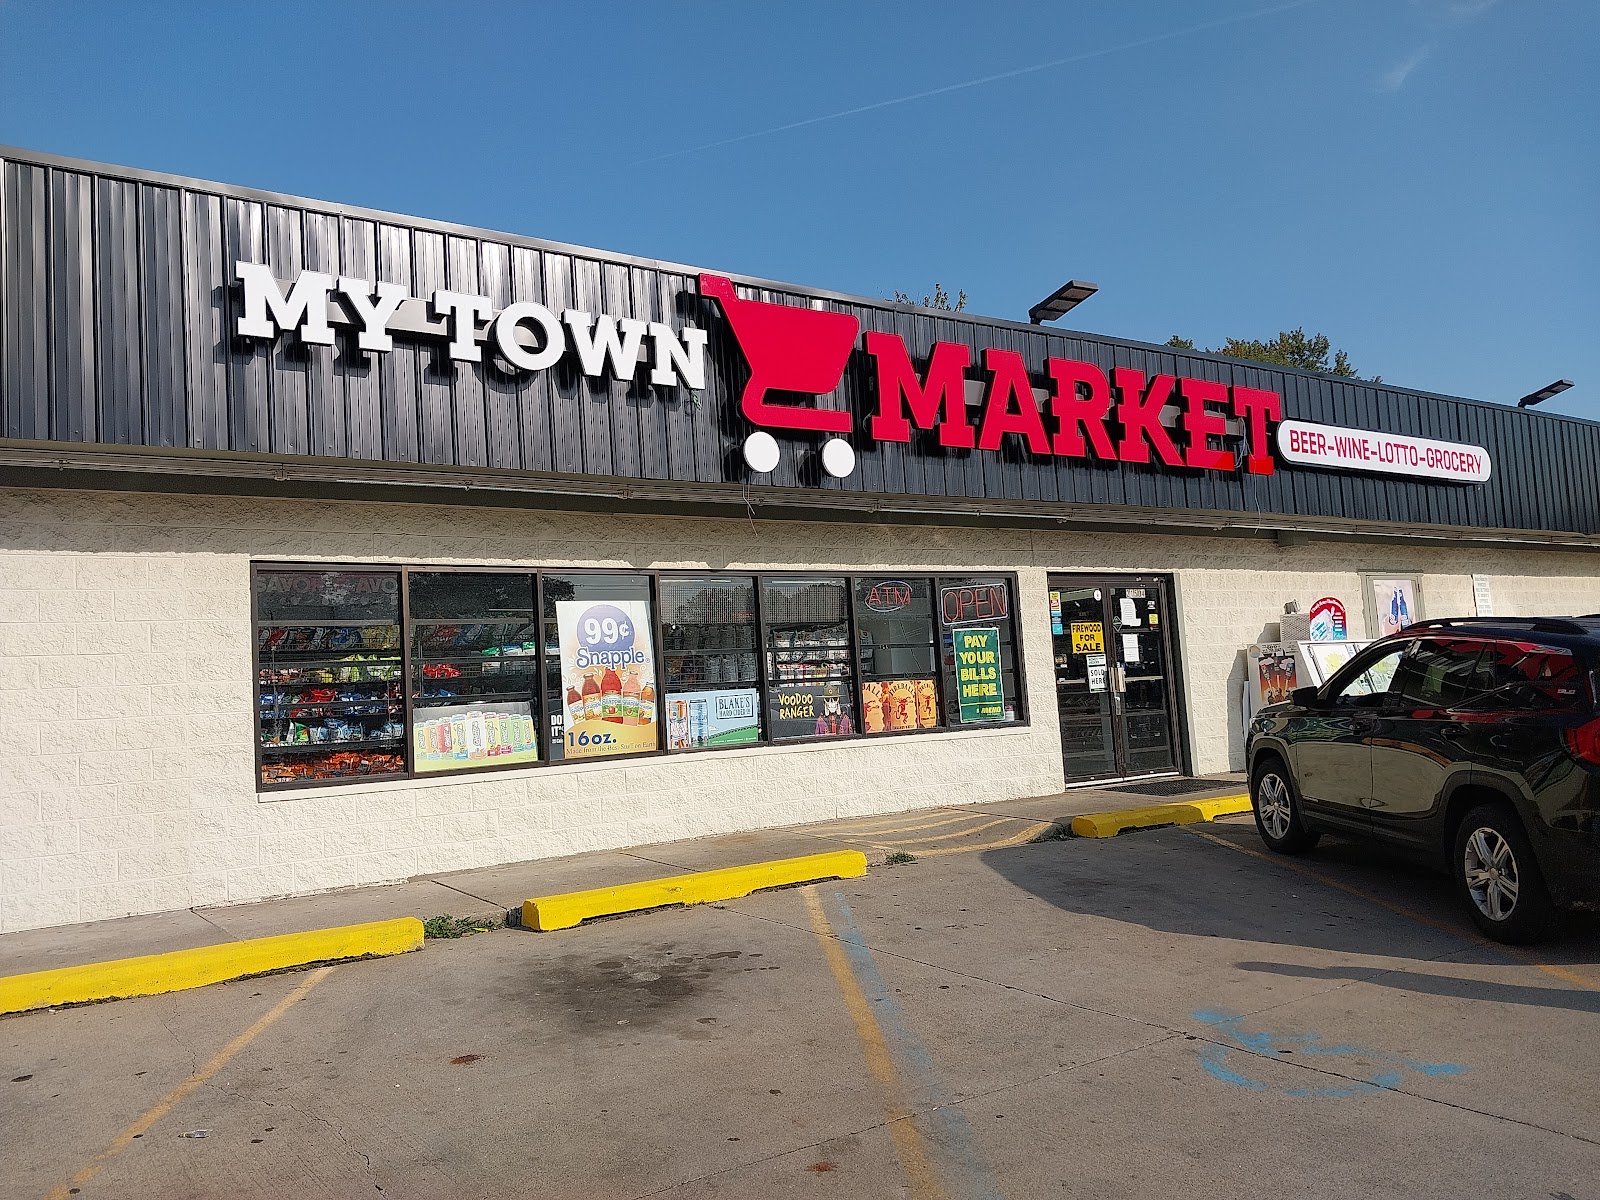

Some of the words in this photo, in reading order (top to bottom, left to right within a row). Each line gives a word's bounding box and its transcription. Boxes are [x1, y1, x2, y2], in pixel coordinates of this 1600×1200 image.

[236, 262, 407, 352] MY
[433, 289, 708, 390] TOWN
[862, 330, 1282, 476] MARKET
[1289, 429, 1482, 475] BEER-WINE-LOTTO-GROCERY
[868, 587, 911, 605] ATM
[943, 586, 1006, 622] OPEN
[1072, 623, 1102, 633] FIREWOOD
[964, 635, 988, 648] PAY
[1075, 643, 1101, 652] SALE
[576, 647, 645, 670] Snapple
[959, 651, 995, 664] YOUR
[960, 667, 997, 681] BILLS
[962, 683, 998, 697] HERE
[719, 696, 751, 709] BLAKE'S
[778, 692, 813, 706] VOODOO
[780, 705, 815, 719] RANGER
